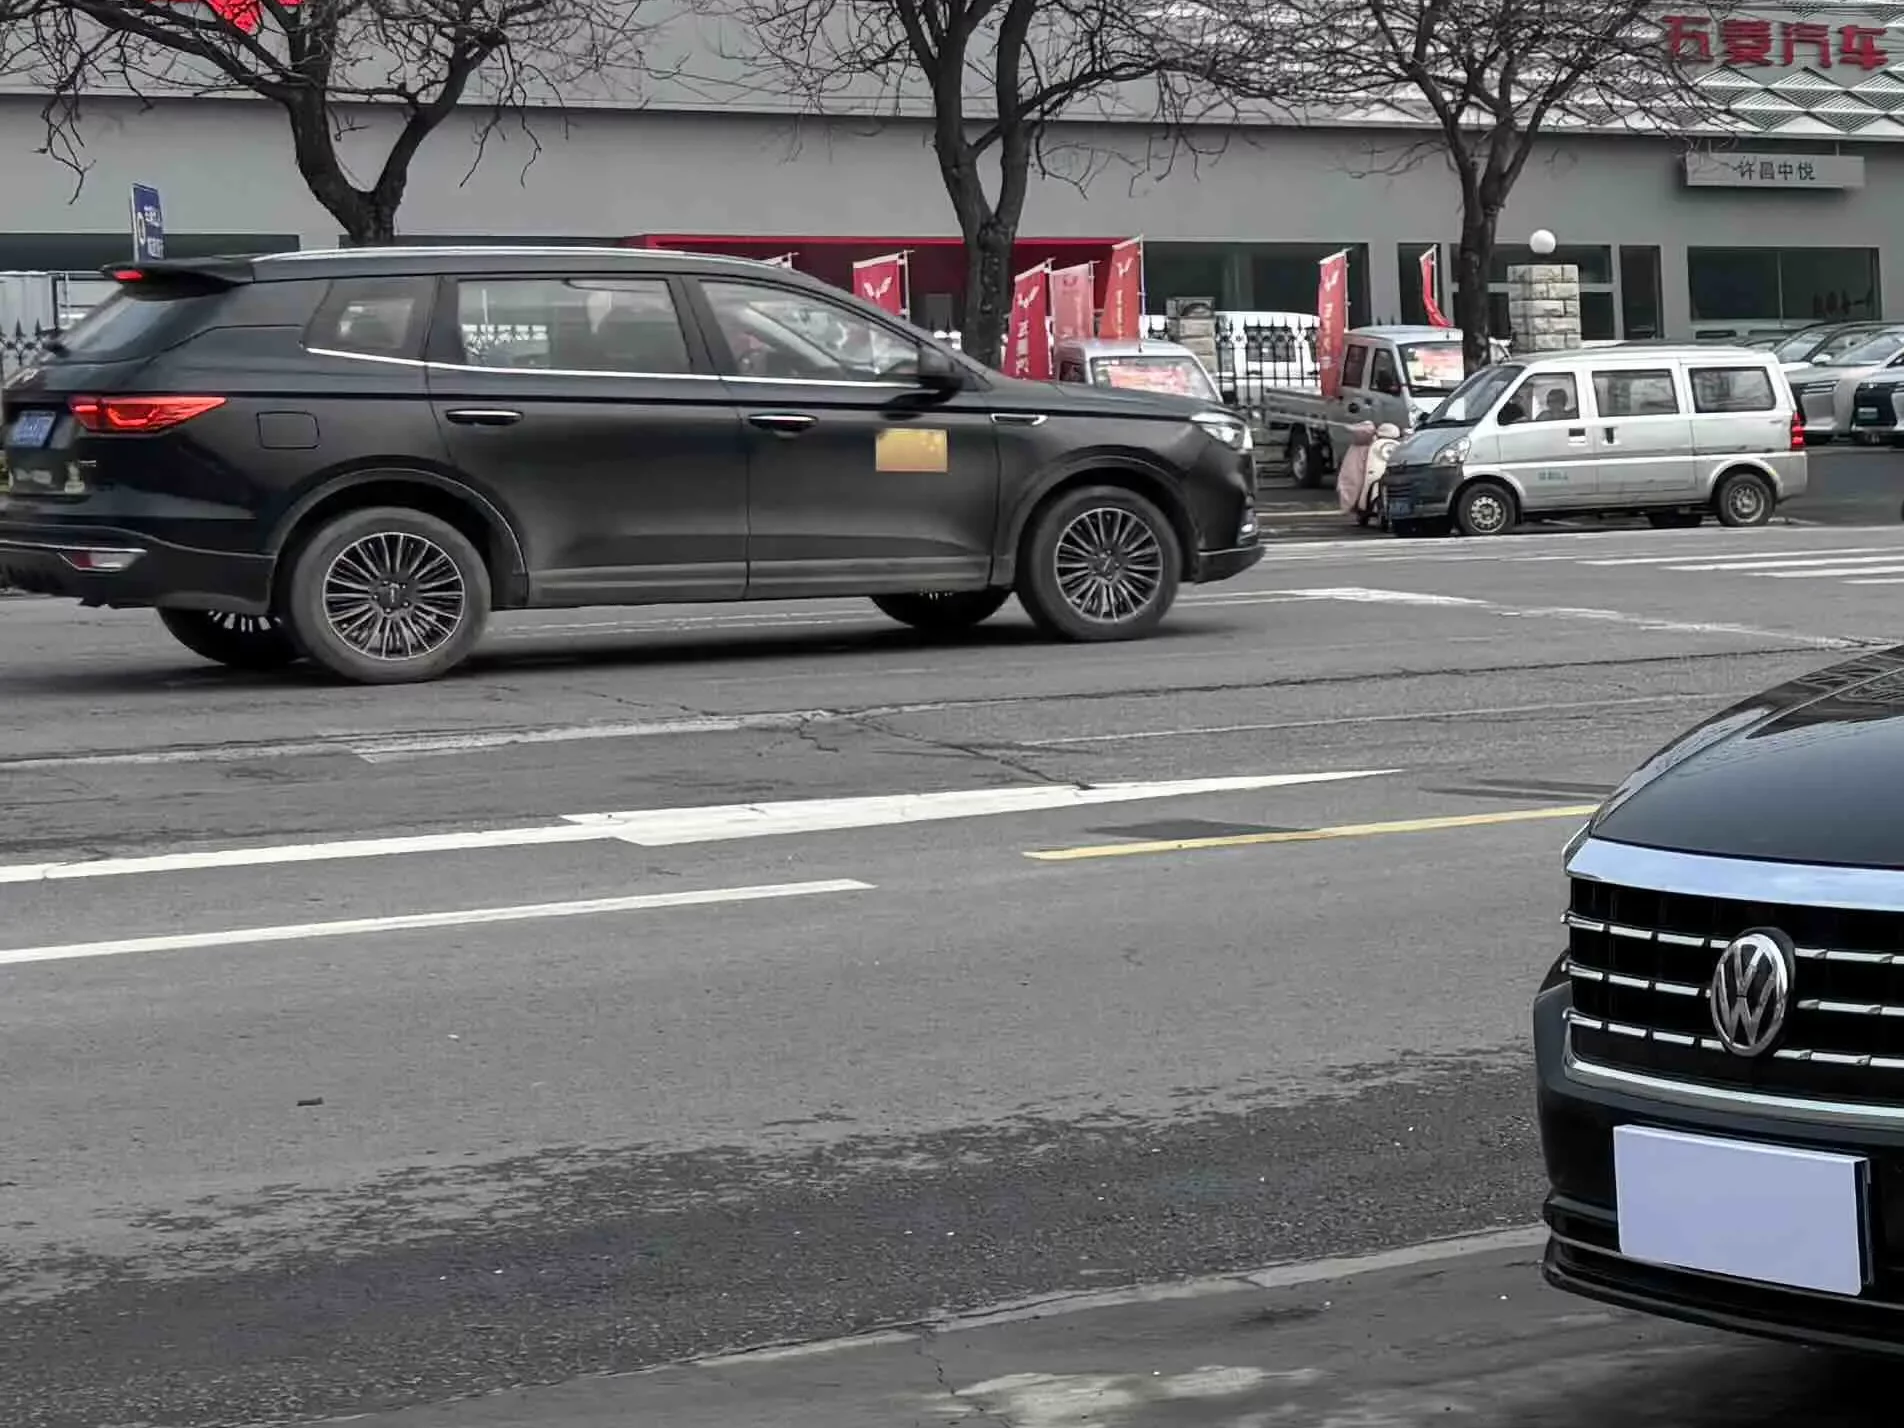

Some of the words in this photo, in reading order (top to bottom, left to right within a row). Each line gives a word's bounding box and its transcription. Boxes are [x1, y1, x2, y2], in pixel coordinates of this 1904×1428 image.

[1659, 15, 1887, 70] 五菱汽车
[1738, 156, 1816, 181] 许昌中悦
